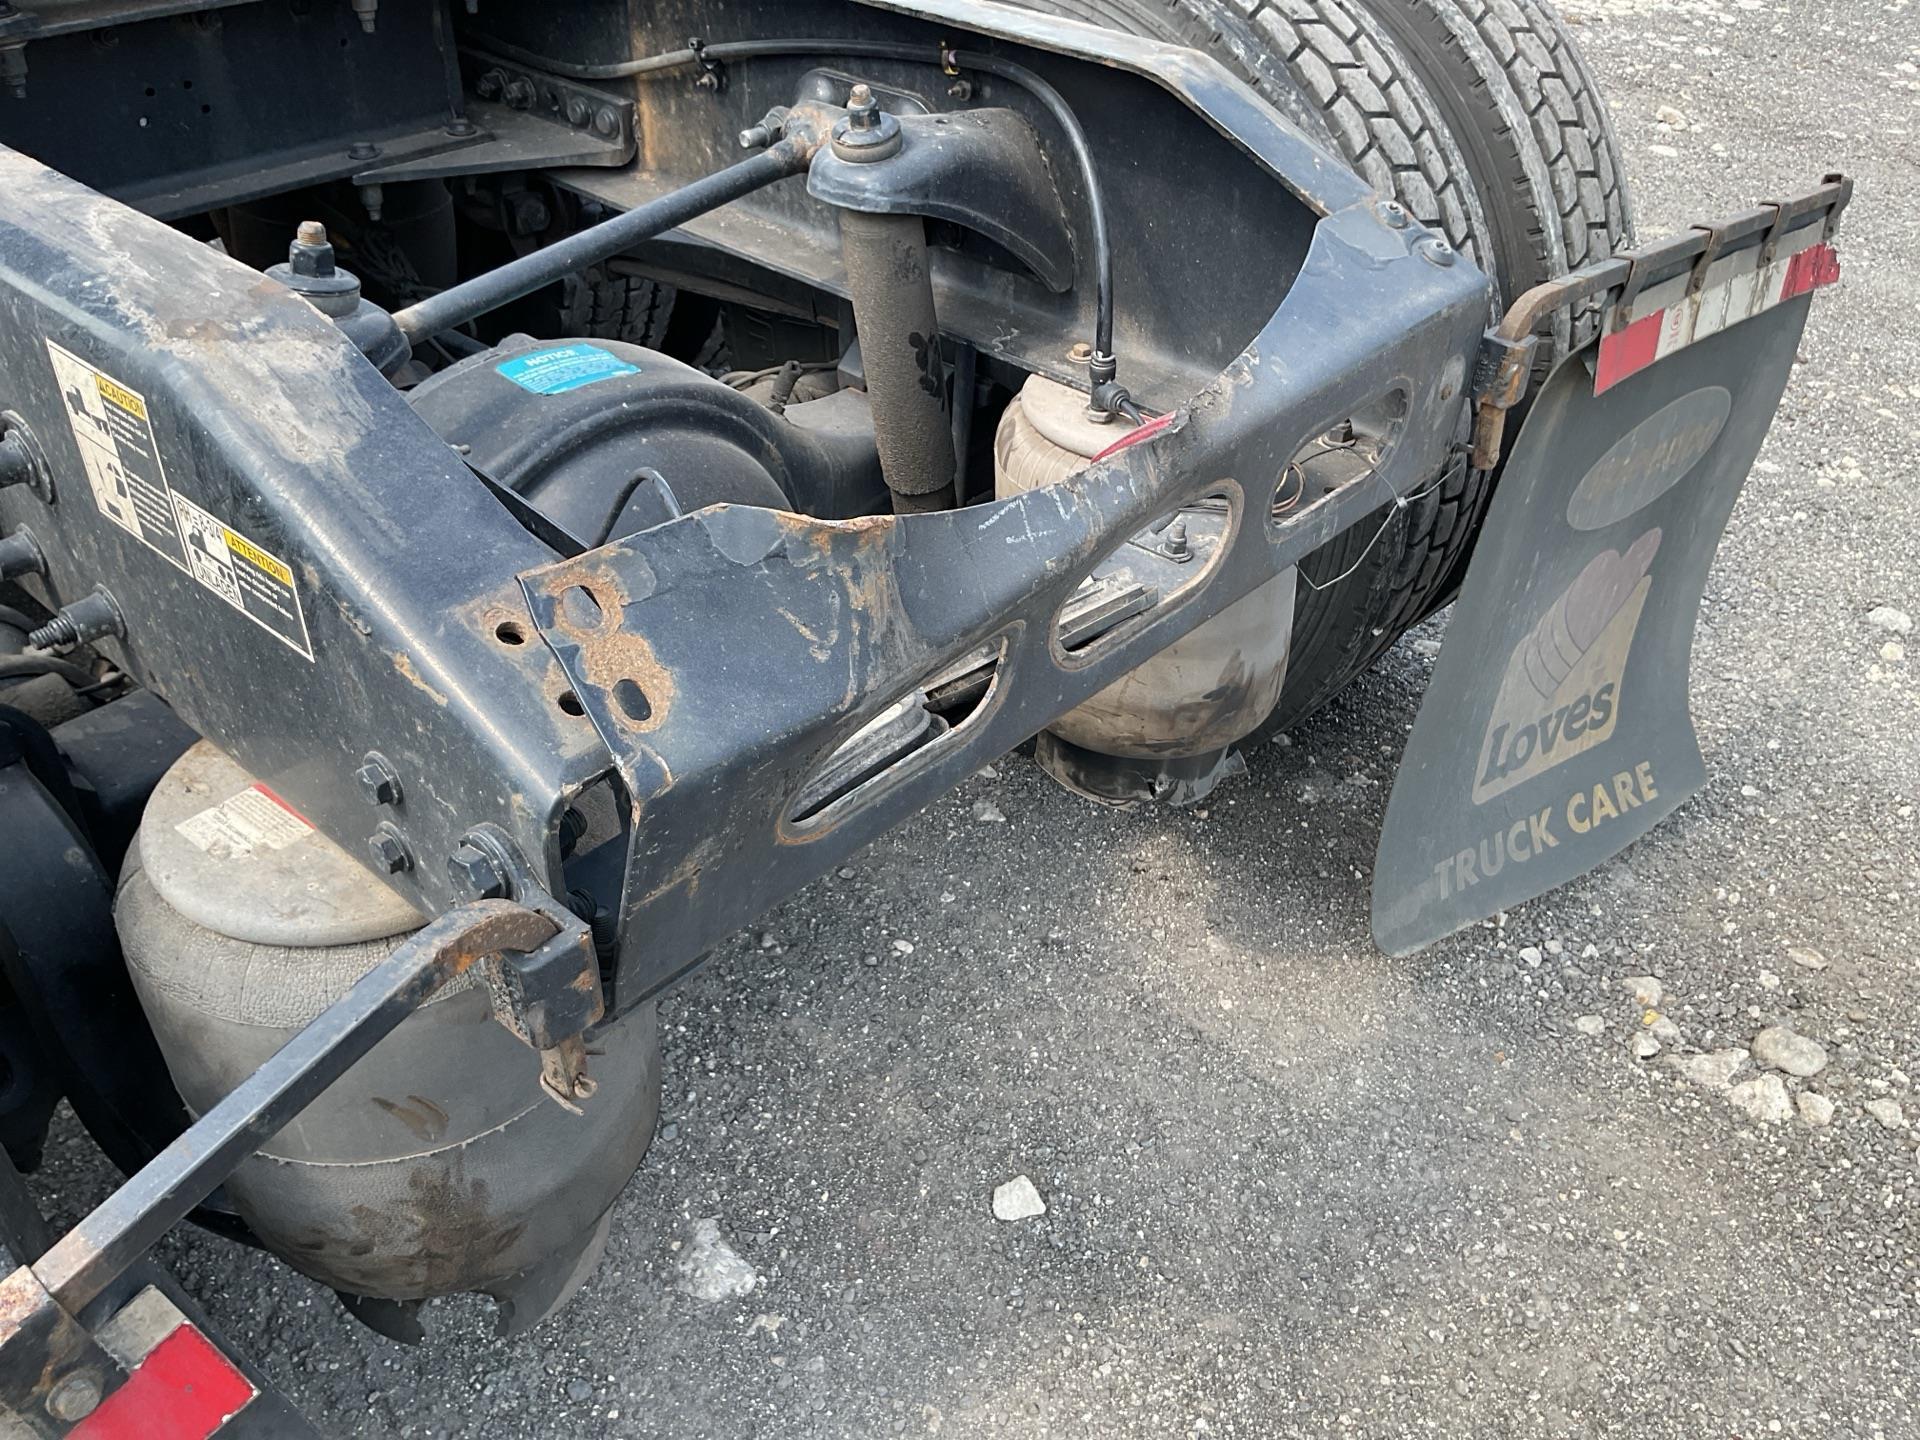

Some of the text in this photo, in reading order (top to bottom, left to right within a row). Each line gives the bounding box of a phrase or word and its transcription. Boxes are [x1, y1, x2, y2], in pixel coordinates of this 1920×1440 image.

[103, 382, 144, 417] CAUTION
[231, 537, 284, 580] ATTENTION
[195, 562, 242, 604] UNLADEN
[1434, 761, 1659, 900] TRUCK CARE
